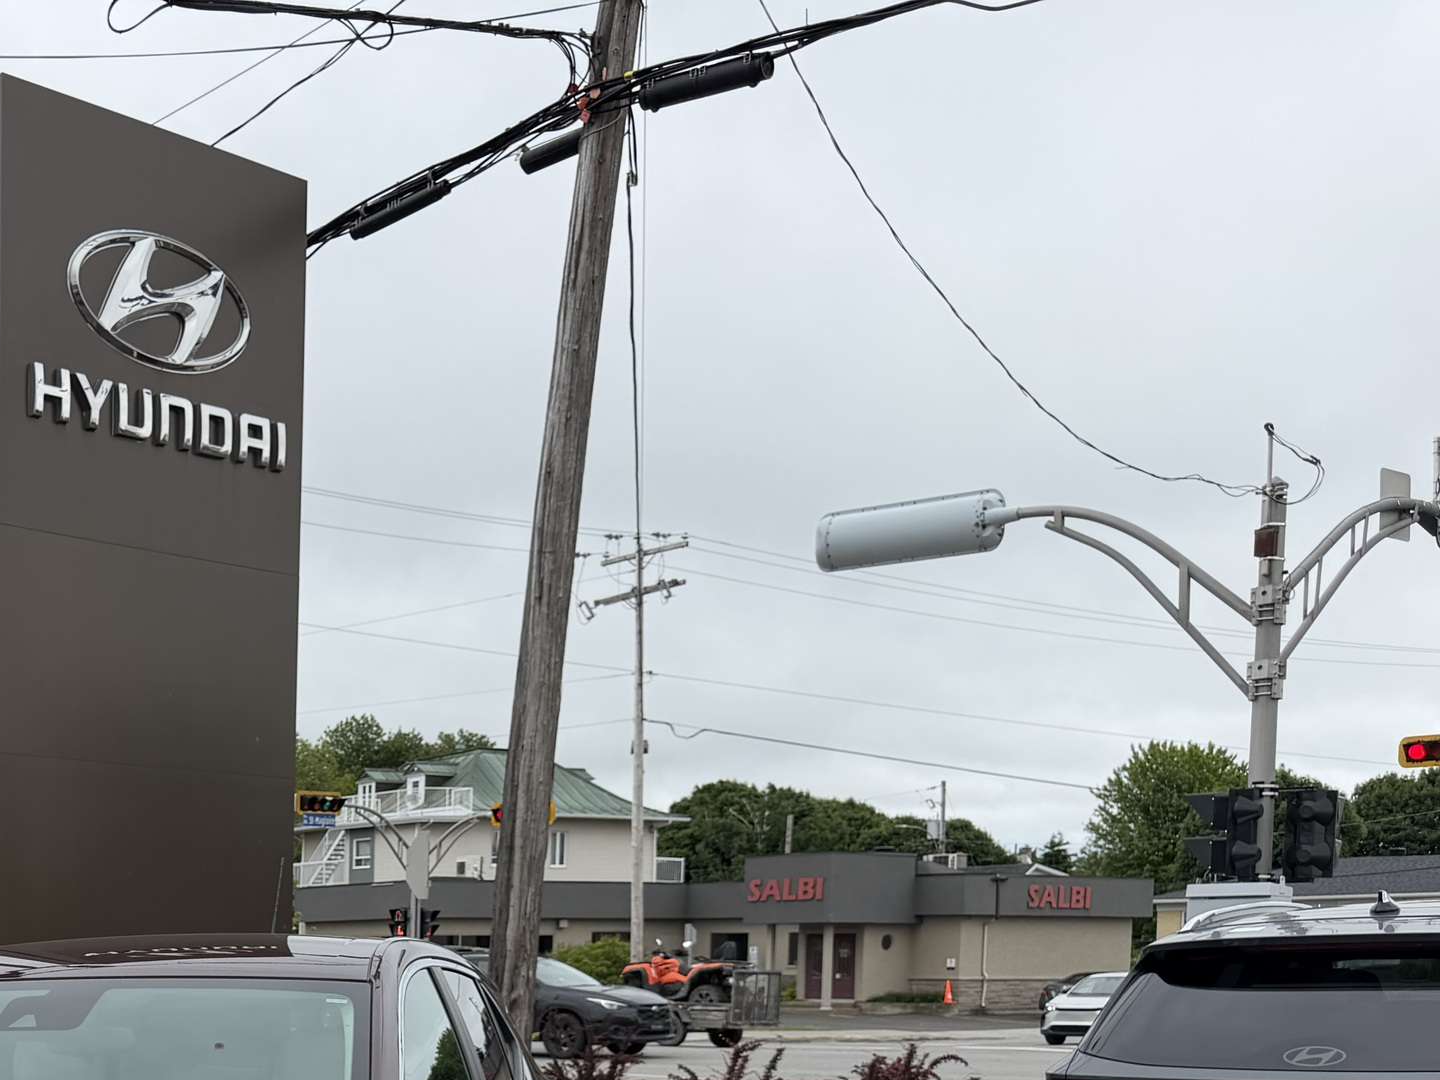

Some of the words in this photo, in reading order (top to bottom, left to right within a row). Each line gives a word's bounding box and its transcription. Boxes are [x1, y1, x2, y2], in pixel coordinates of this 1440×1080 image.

[30, 361, 287, 472] HYUNDAI
[747, 877, 824, 902] SALBI
[1028, 884, 1092, 909] SALBI
